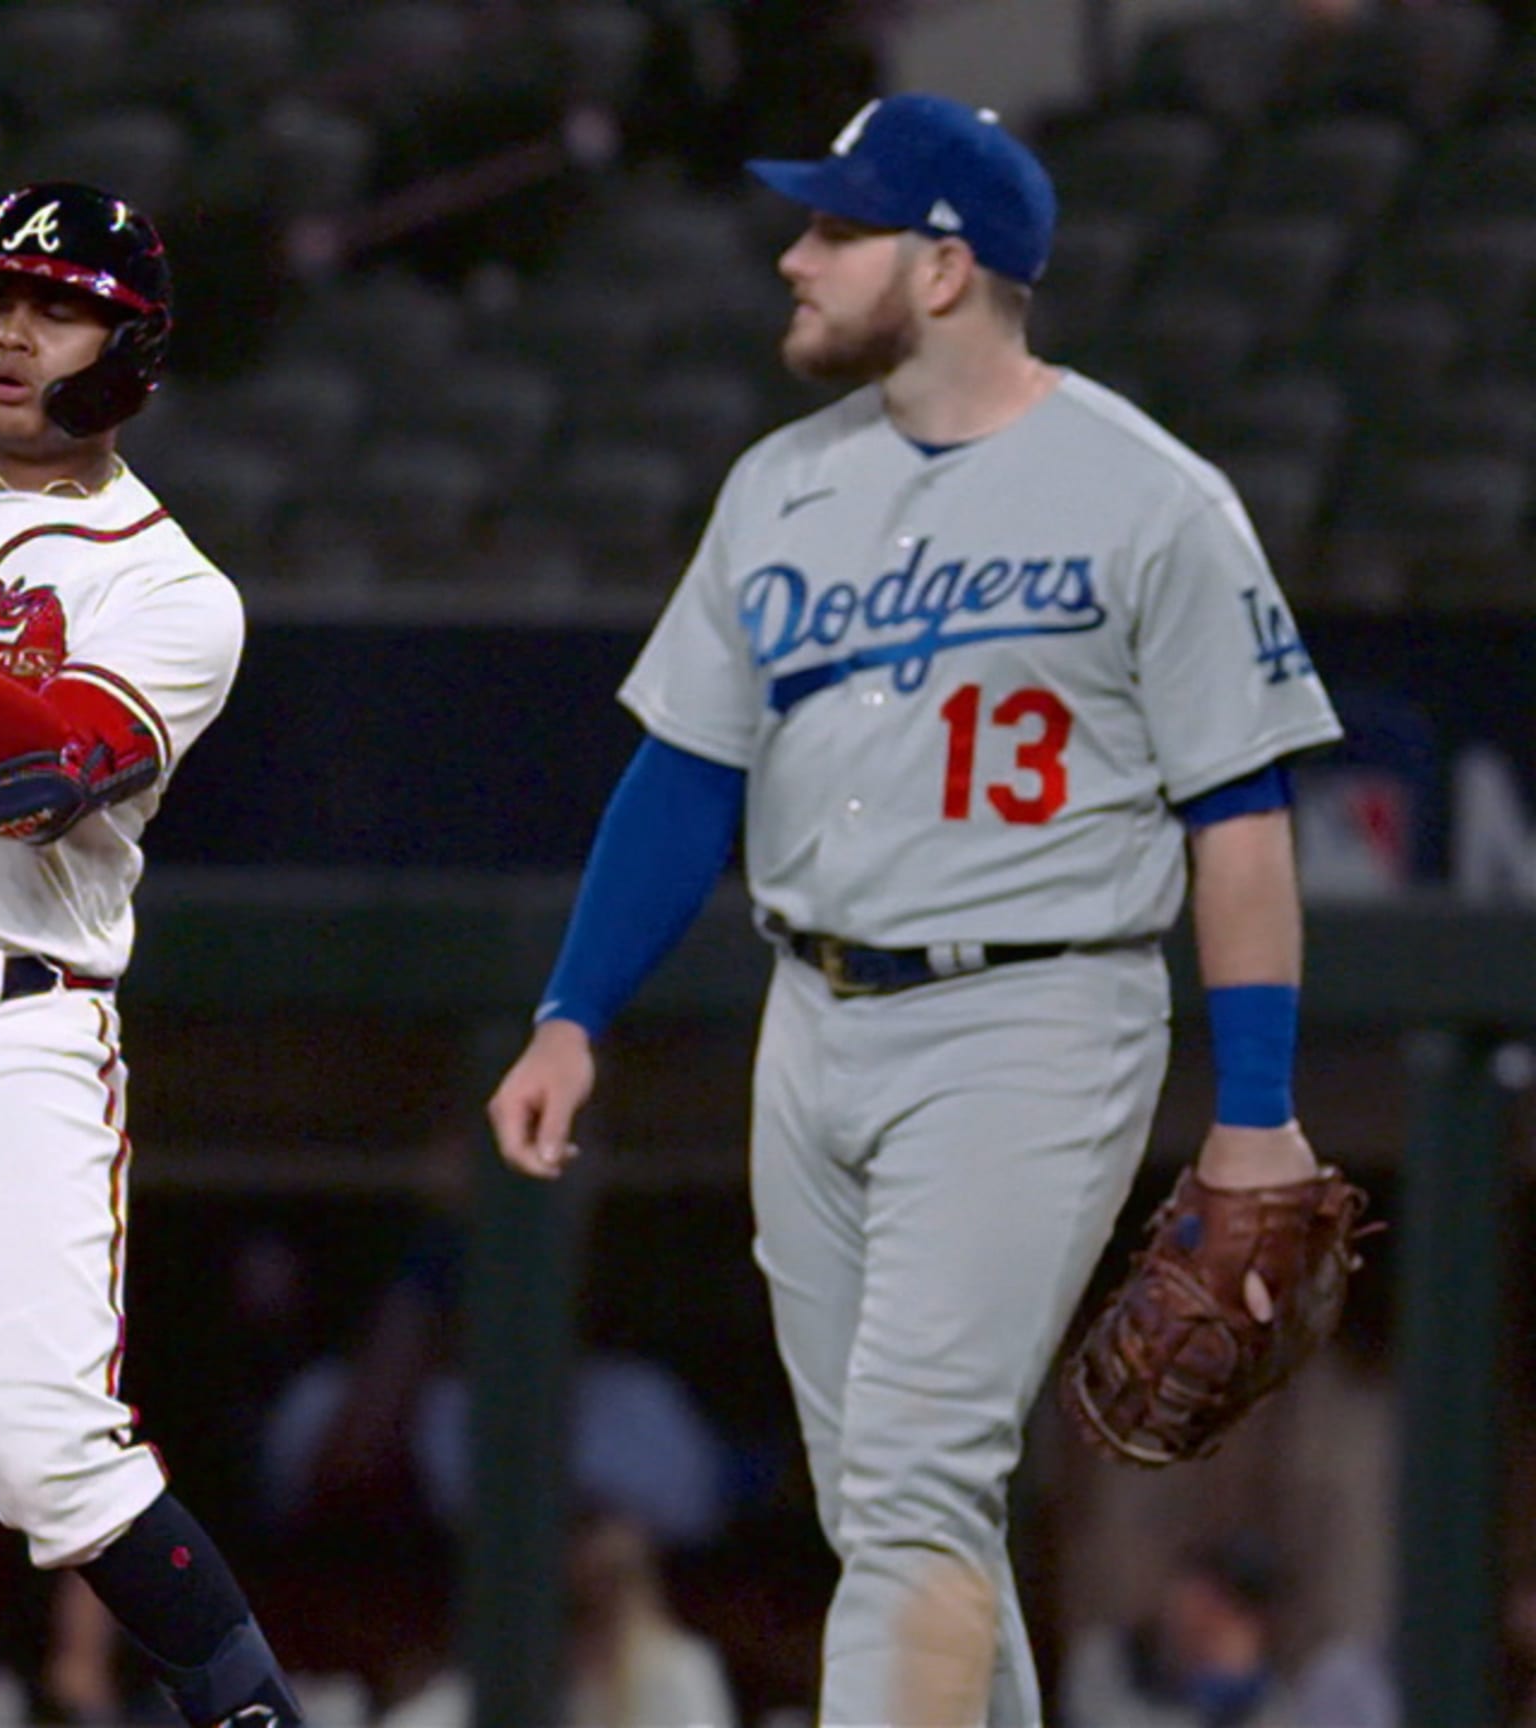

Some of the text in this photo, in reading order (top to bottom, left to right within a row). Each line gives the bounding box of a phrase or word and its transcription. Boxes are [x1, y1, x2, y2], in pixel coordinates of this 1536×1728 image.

[2, 201, 60, 251] A
[739, 537, 1106, 697] Dodgers
[1240, 587, 1314, 685] LA
[940, 683, 1073, 826] 13
